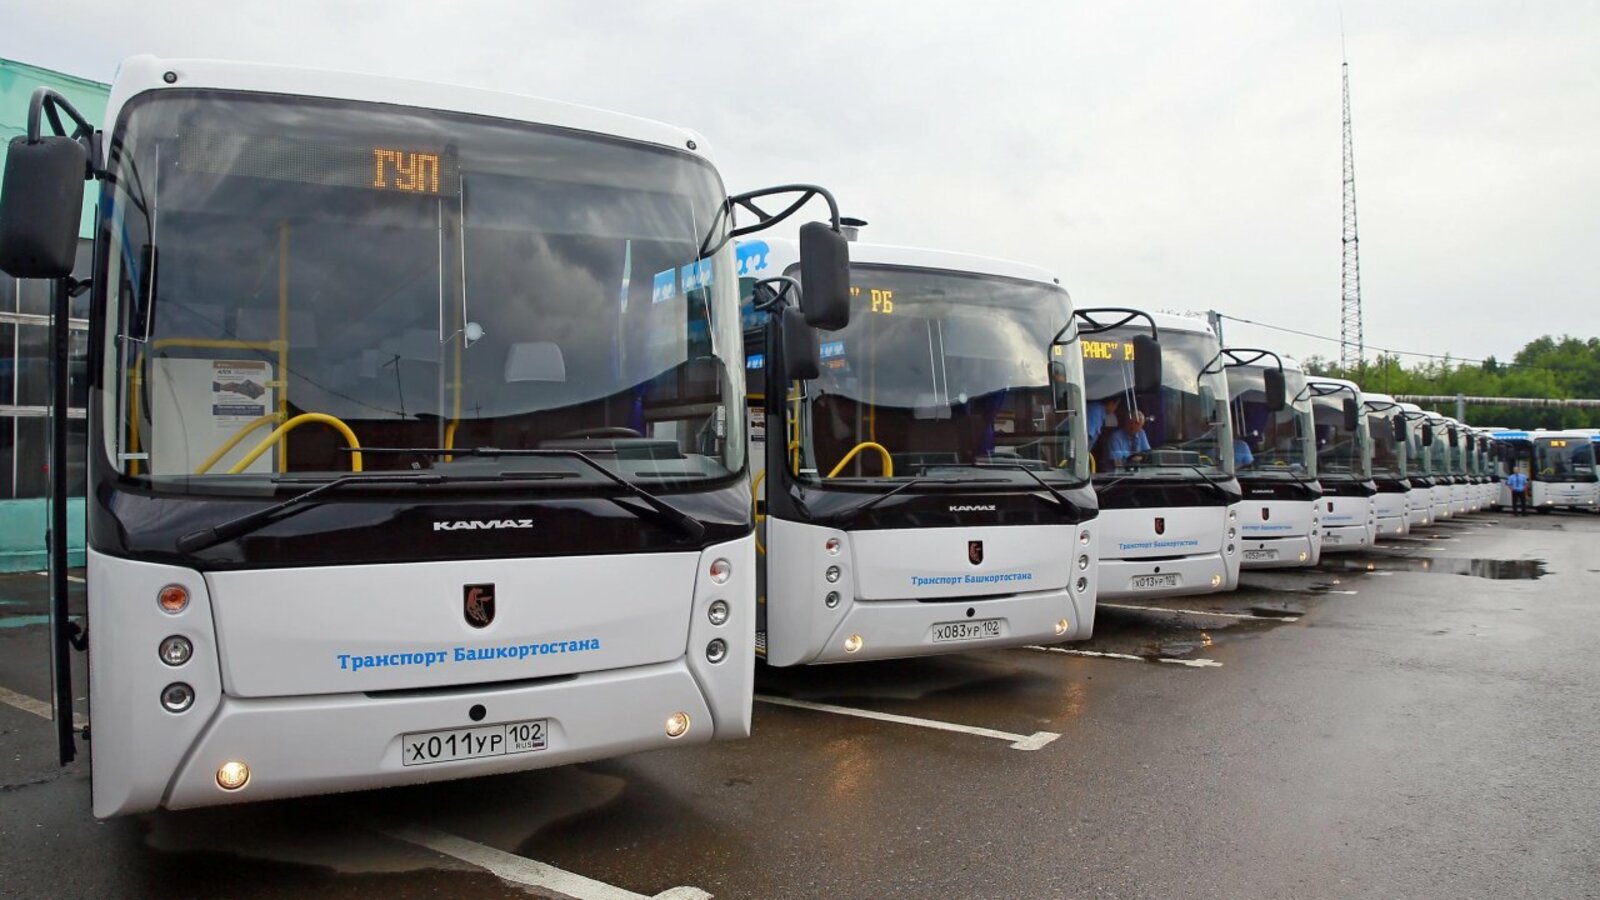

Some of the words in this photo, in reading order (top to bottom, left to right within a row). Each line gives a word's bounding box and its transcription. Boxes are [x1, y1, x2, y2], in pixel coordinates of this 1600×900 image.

[374, 149, 438, 192] ГУП
[870, 289, 893, 314] РБ
[949, 504, 996, 512] KAMAZ
[433, 519, 533, 531] KAMAZ
[910, 576, 962, 587] Транспорт
[964, 572, 1032, 584] Башкортостана
[337, 651, 448, 671] Транспорт
[453, 638, 601, 662] Башкортостана
[411, 732, 503, 761] Х011УР
[509, 723, 541, 742] 102
[515, 742, 532, 750] RUS
